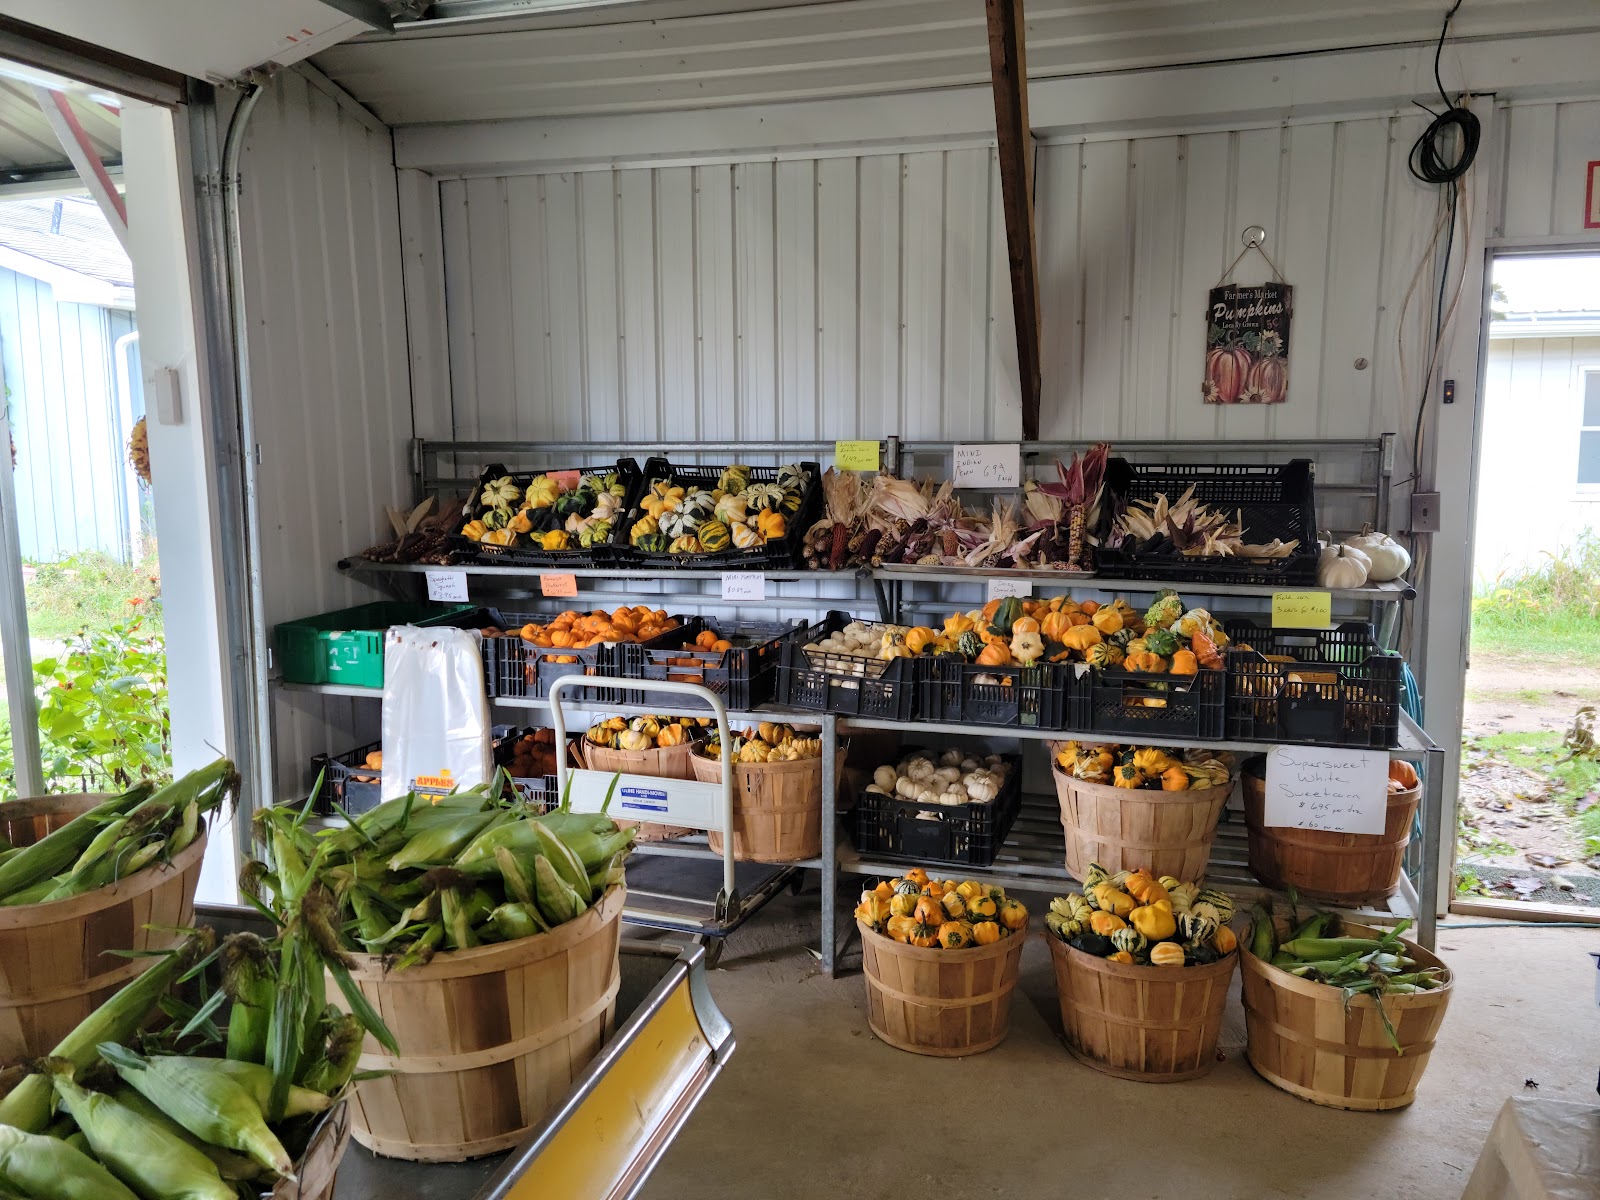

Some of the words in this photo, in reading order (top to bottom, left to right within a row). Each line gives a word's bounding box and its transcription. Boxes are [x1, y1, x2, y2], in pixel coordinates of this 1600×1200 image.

[1224, 290, 1254, 301] Farmer's
[1254, 289, 1277, 299] Market
[1213, 298, 1284, 323] Pumpkins
[1242, 321, 1259, 329] Grown
[957, 449, 982, 458] MINI
[959, 469, 974, 477] CORN
[997, 474, 1013, 483] EACH
[428, 574, 455, 583] Spaghetti
[435, 582, 456, 591] Squash
[1276, 606, 1283, 614] 3
[1276, 748, 1370, 770] Supersweet
[416, 776, 454, 787] APPLES
[1297, 771, 1351, 783] White
[1278, 783, 1361, 799] Sweetcorn
